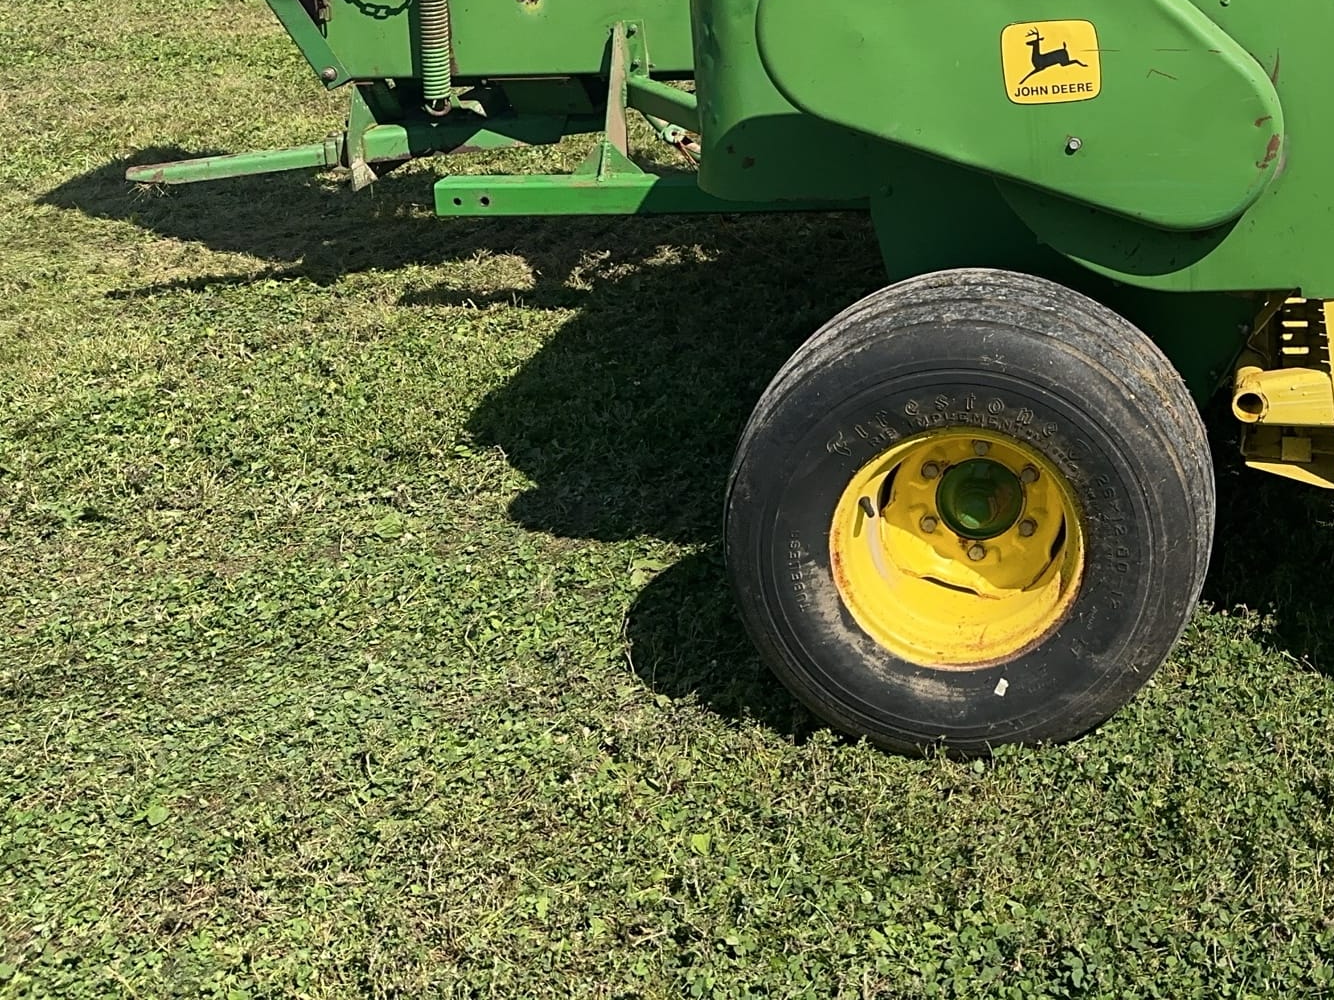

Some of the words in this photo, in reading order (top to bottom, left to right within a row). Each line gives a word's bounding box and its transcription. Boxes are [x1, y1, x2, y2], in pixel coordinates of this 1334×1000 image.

[1014, 85, 1049, 97] JOHN
[1051, 82, 1093, 95] DEERE
[826, 391, 1058, 457] Firestone
[906, 411, 1023, 433] IMPLEMENT
